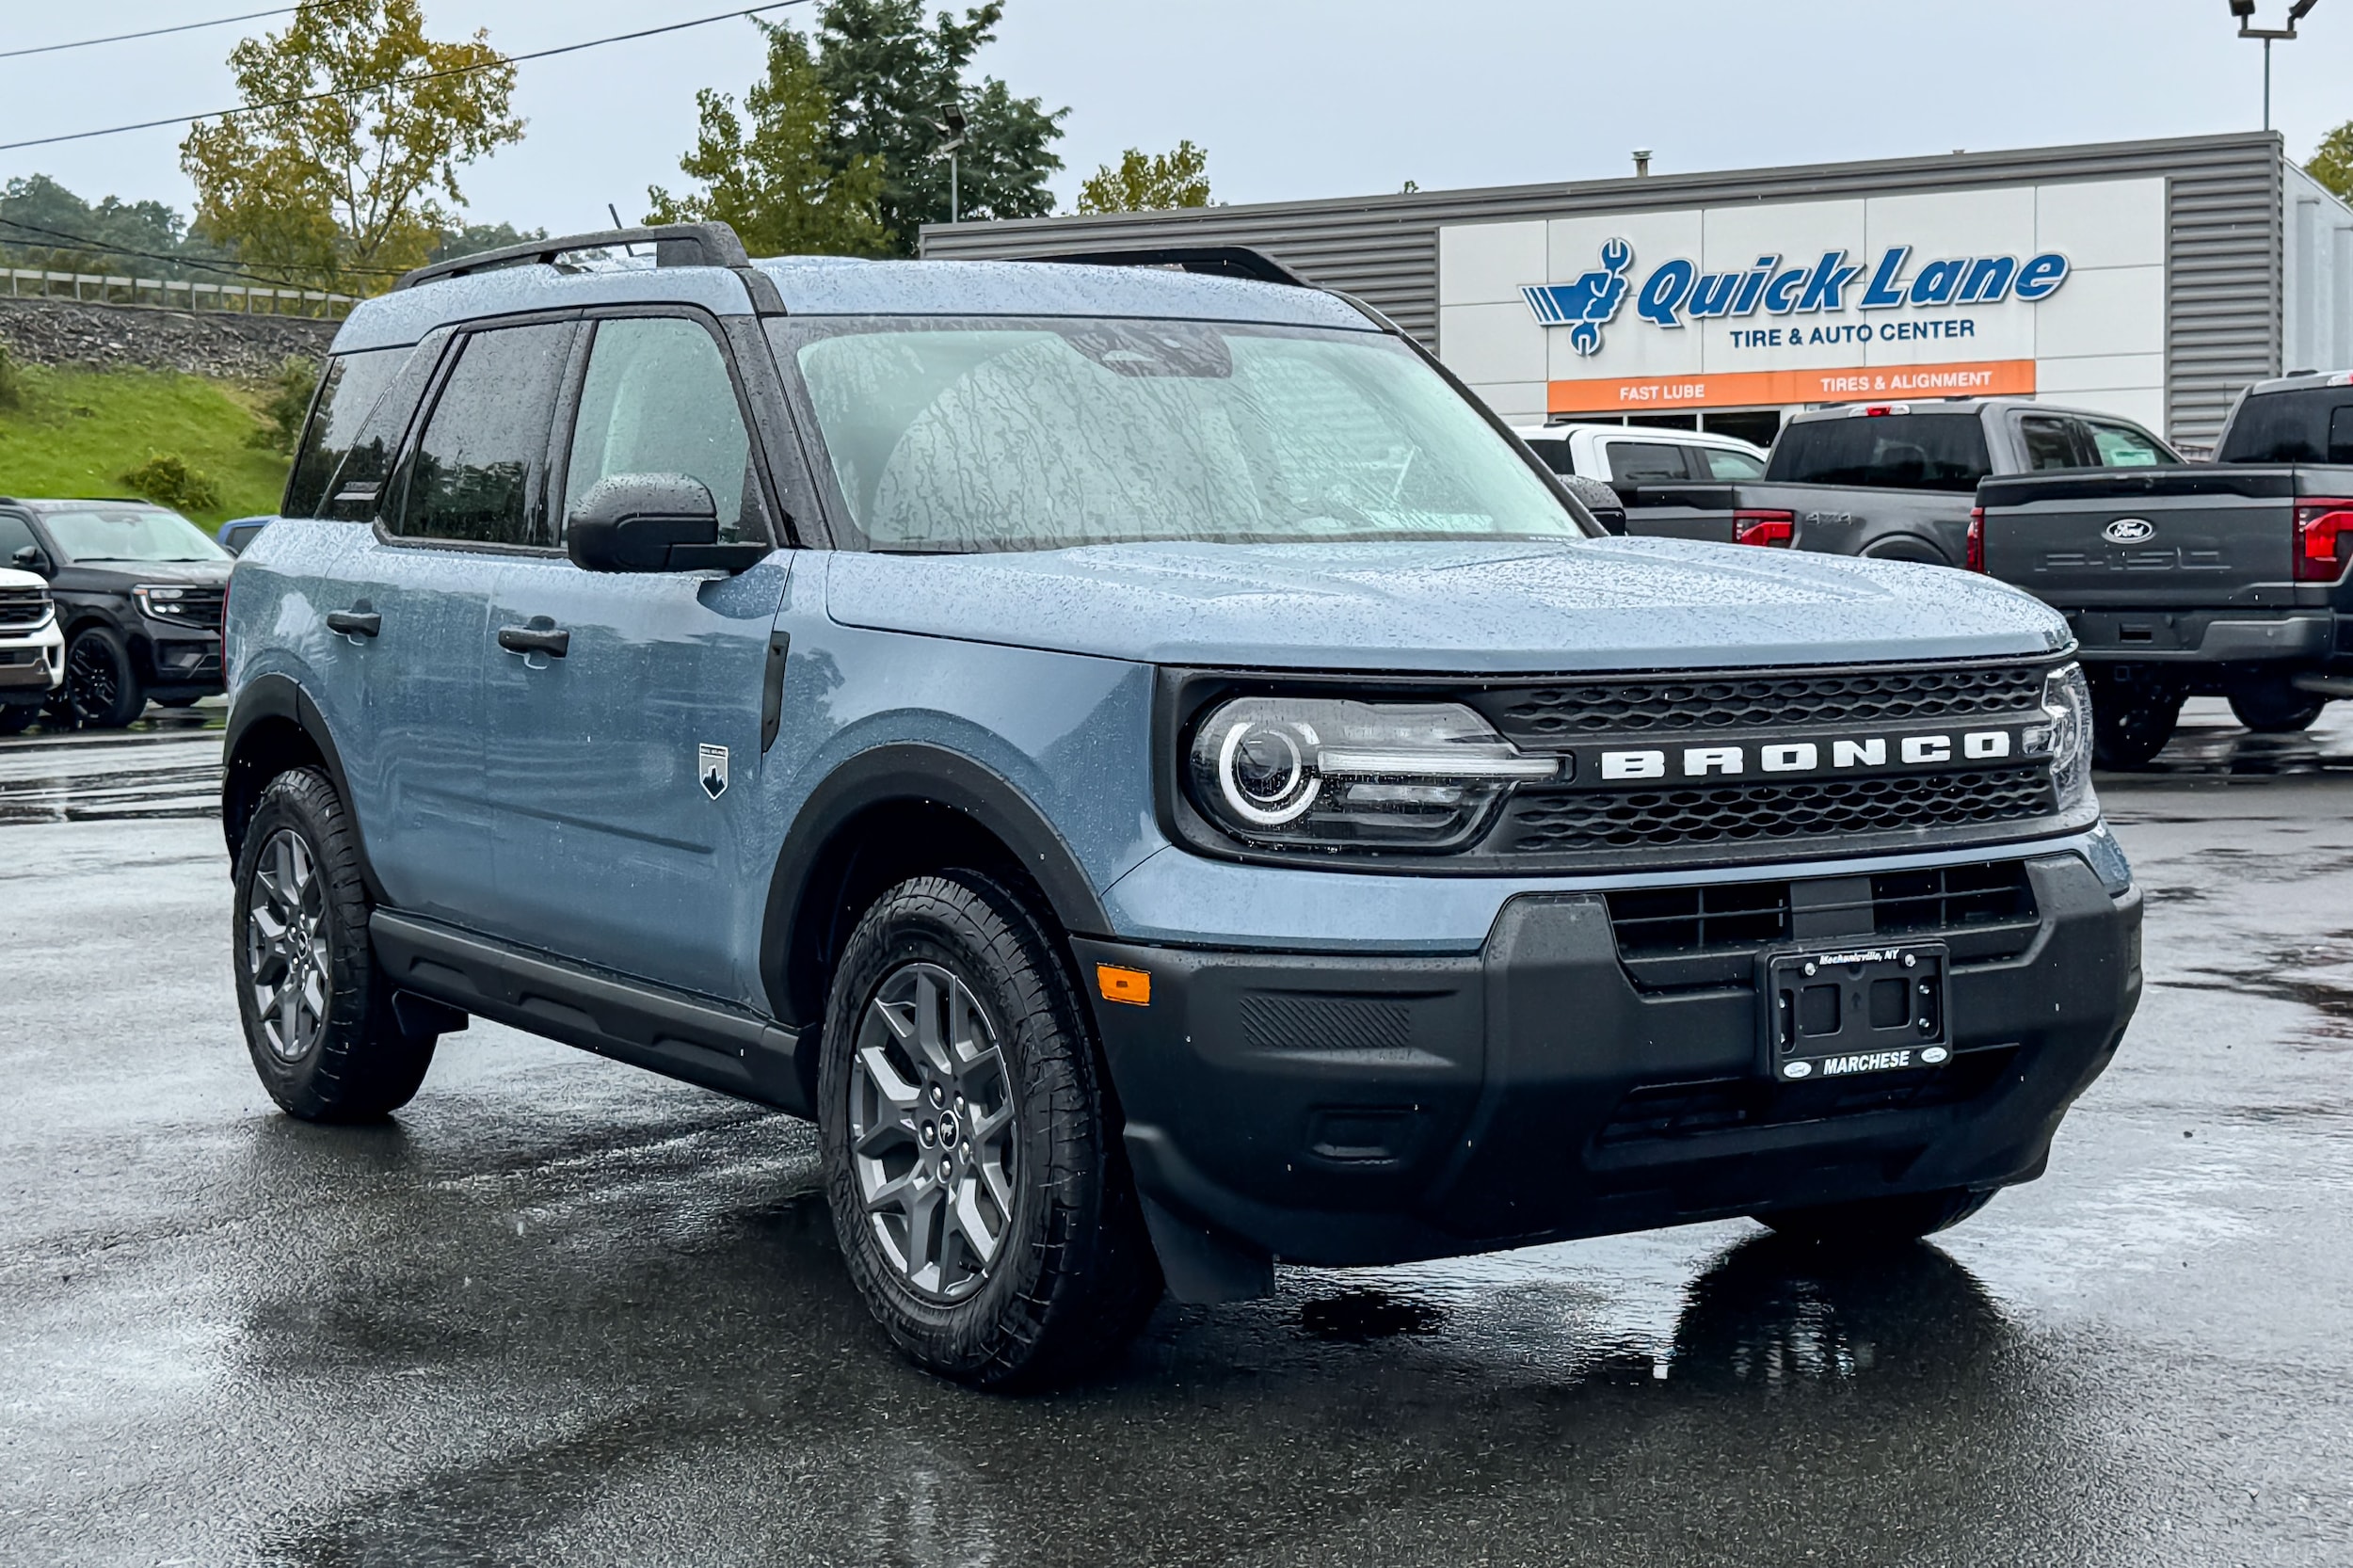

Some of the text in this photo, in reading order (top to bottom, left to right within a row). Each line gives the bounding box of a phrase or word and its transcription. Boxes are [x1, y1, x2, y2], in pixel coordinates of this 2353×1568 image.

[1637, 244, 2071, 328] Quick Lane
[1730, 319, 1976, 348] TIRE & AUTO CENTER
[1620, 384, 1705, 401] FAST LUBE
[1820, 371, 1993, 392] TIRES & ALIGNMENT
[1601, 730, 2009, 779] BRONCO
[1884, 949, 1900, 960] NY
[1823, 1050, 1911, 1076] MARCHESE
